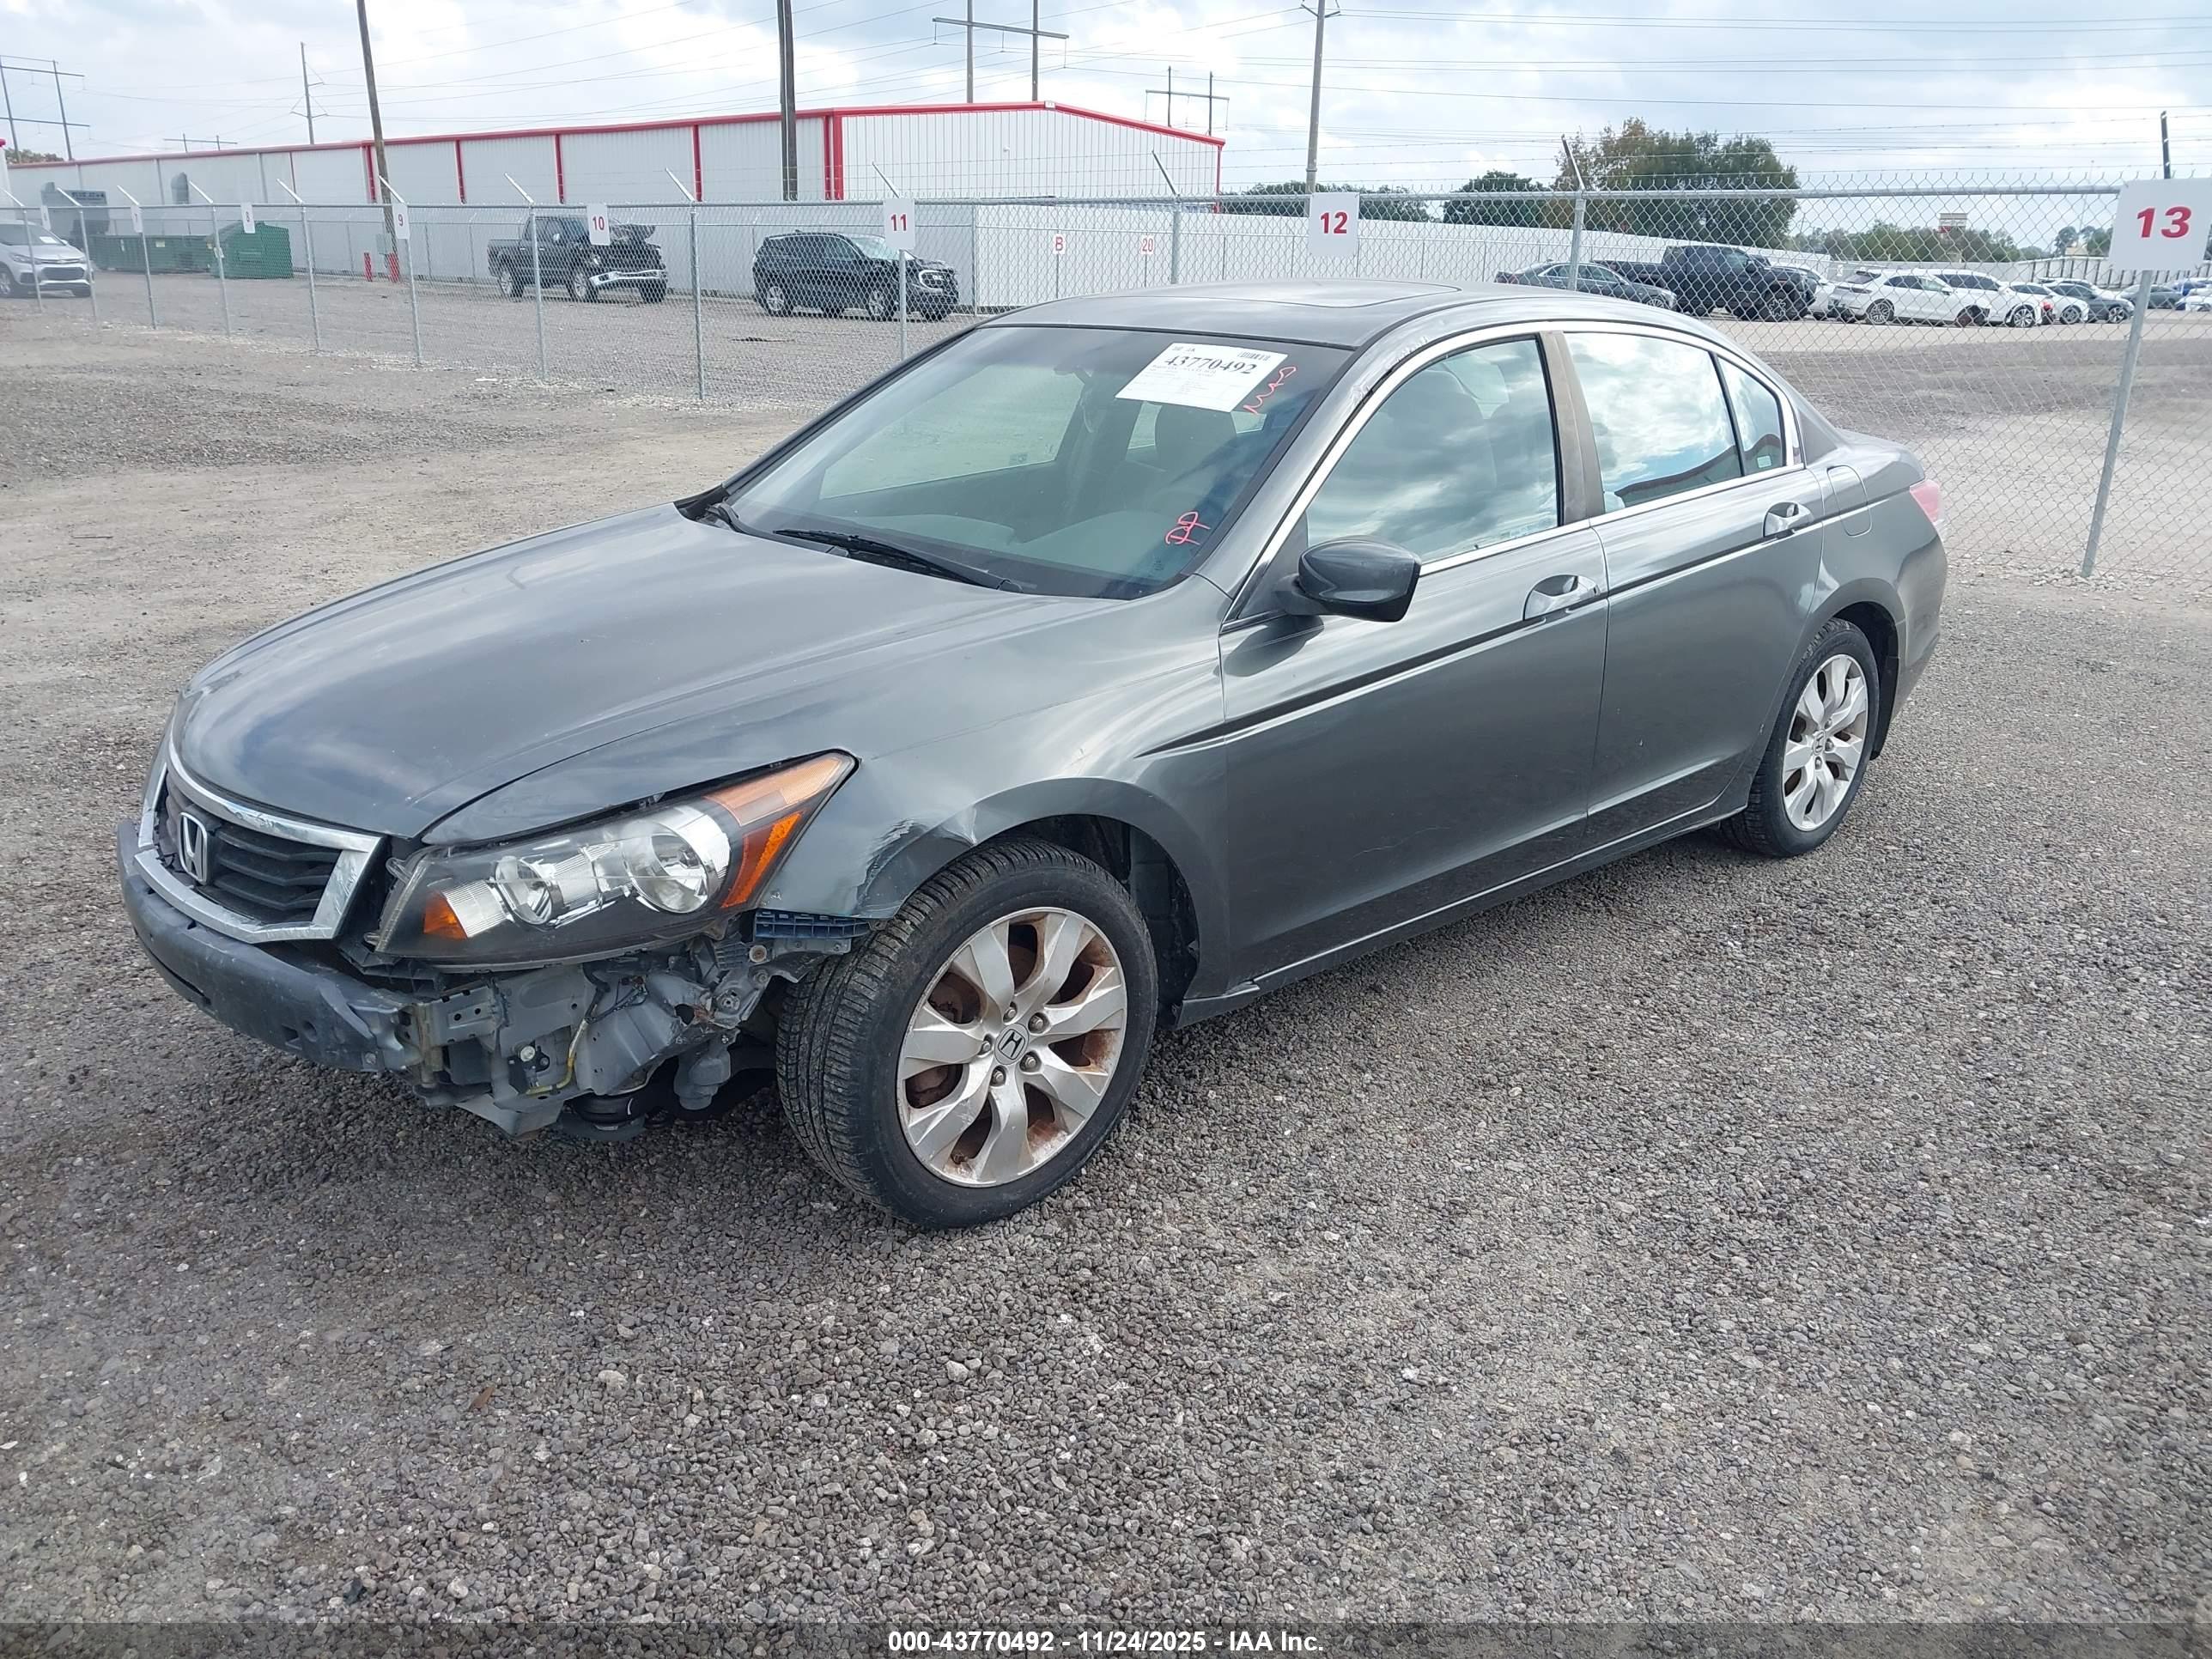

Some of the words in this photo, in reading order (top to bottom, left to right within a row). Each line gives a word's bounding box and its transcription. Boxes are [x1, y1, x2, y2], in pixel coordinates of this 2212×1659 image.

[398, 213, 404, 227] 9
[592, 216, 605, 231] 10
[890, 213, 907, 232] 11
[1320, 211, 1348, 234] 12
[2136, 205, 2192, 239] 13
[1054, 236, 1064, 252] B
[1142, 238, 1154, 252] 20
[1164, 355, 1257, 374] 43770492
